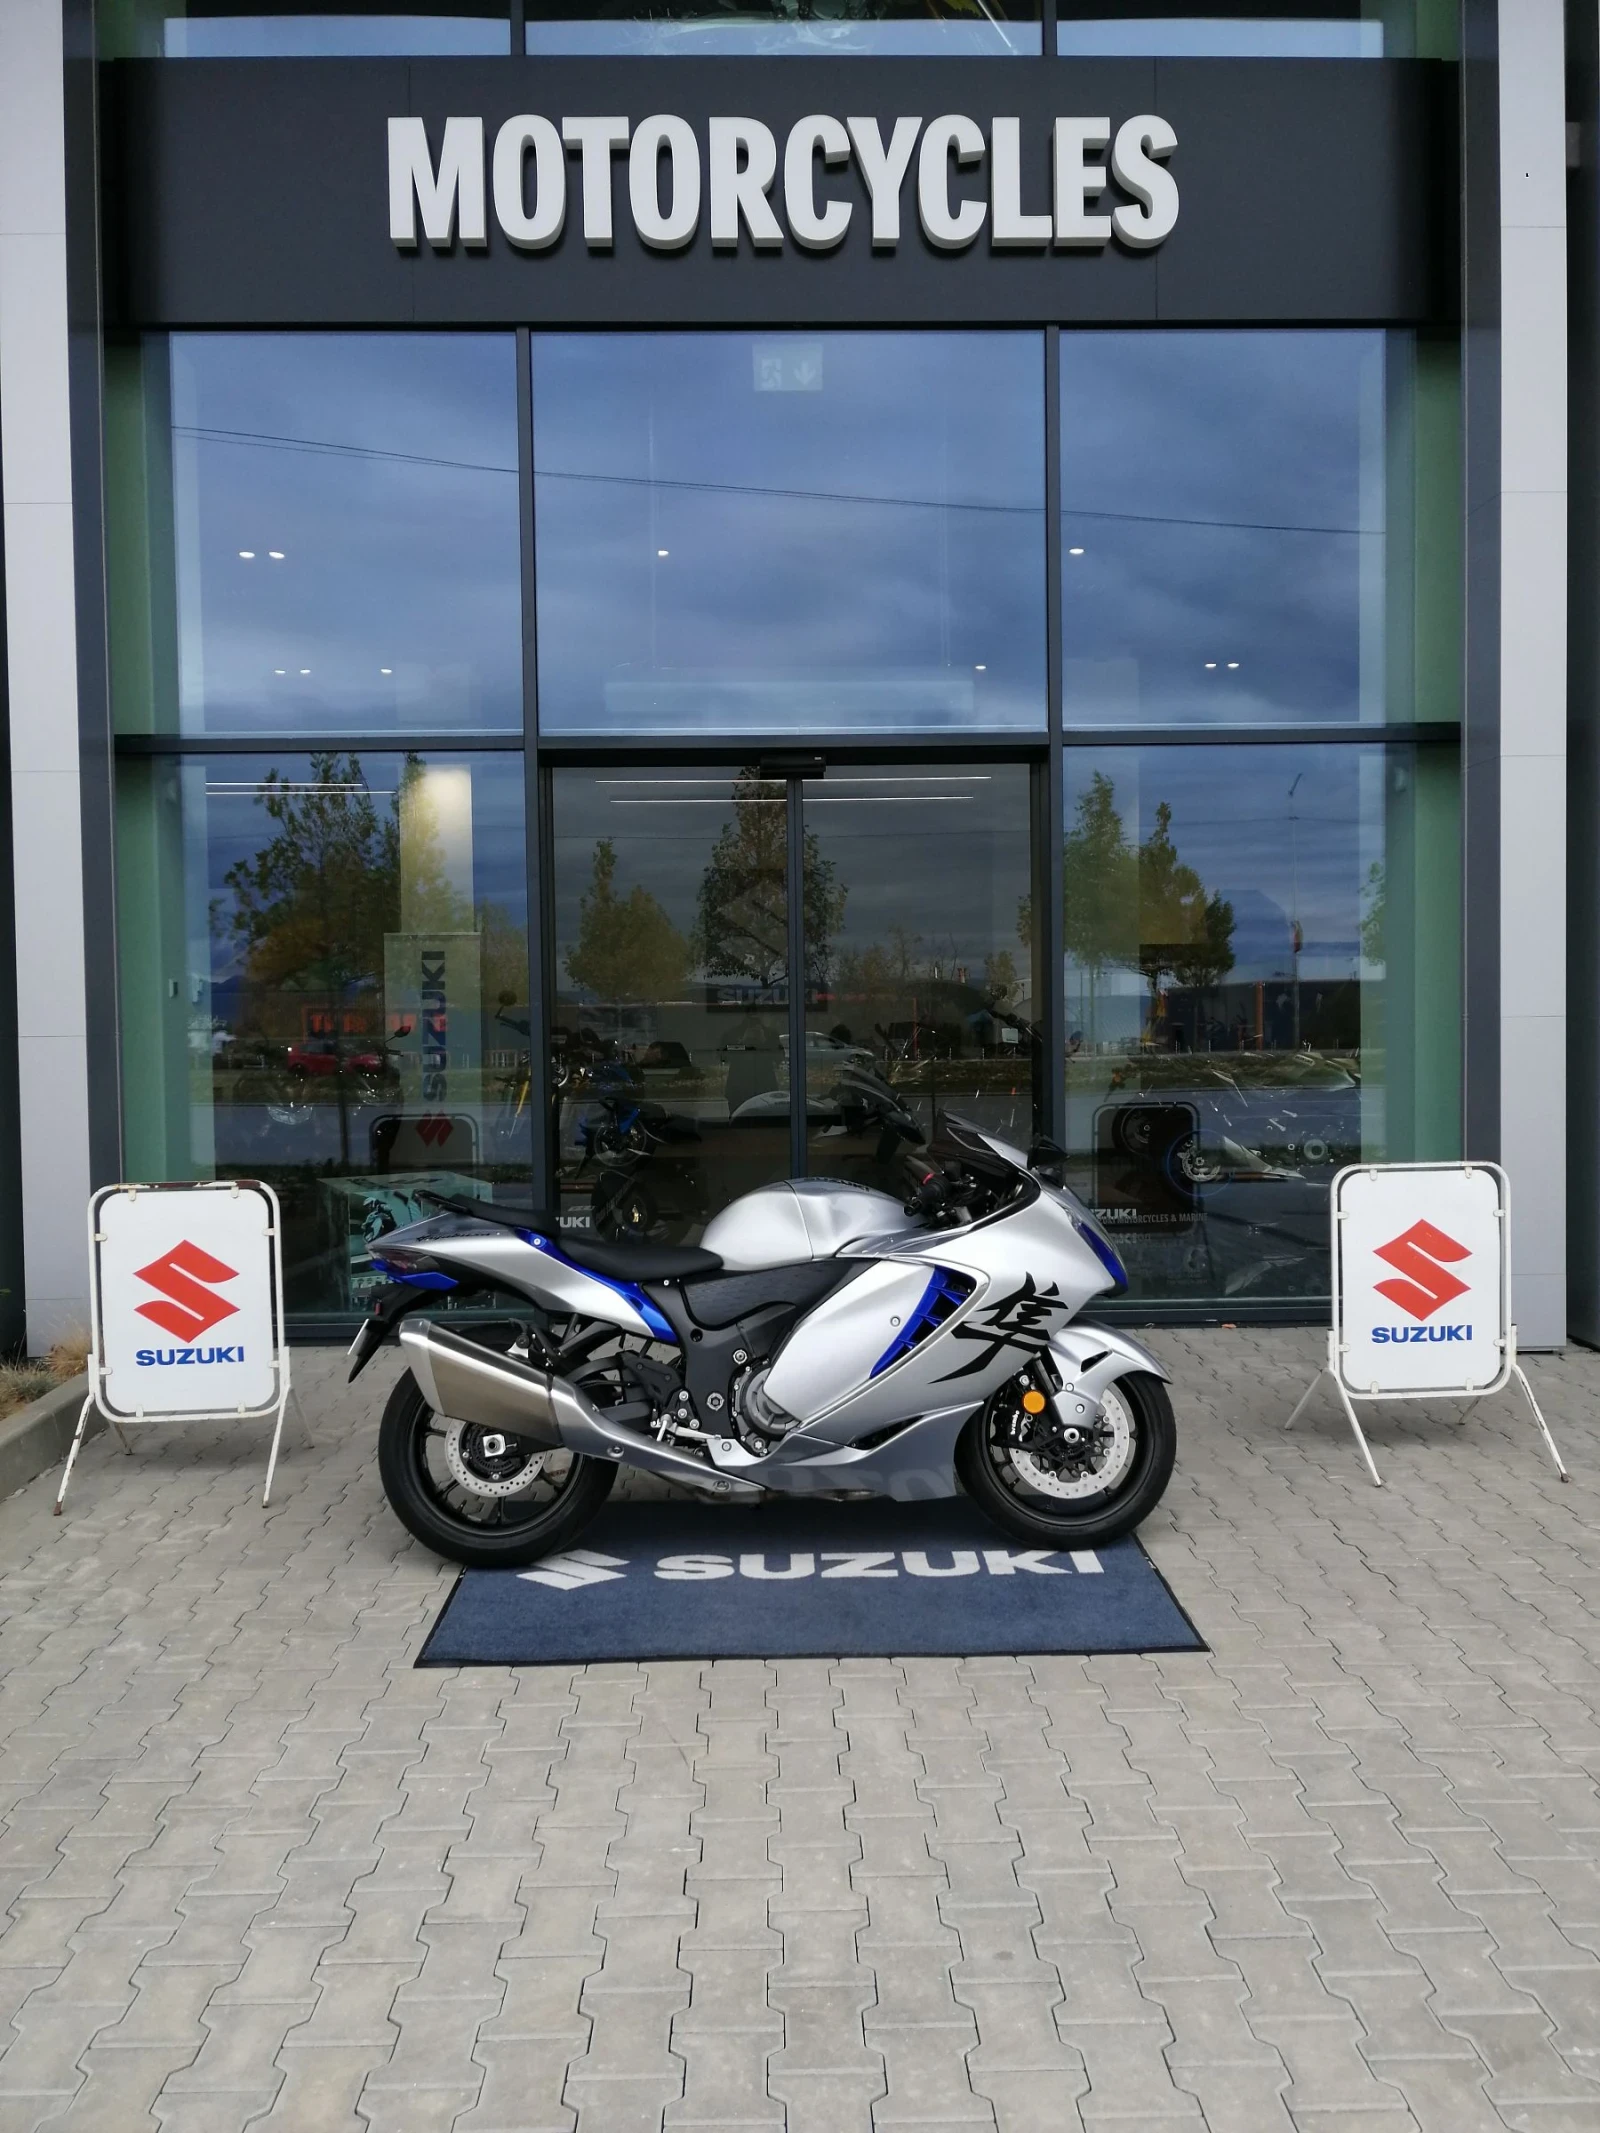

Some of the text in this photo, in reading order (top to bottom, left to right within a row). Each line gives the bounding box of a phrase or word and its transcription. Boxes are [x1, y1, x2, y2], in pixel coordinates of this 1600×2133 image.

[387, 114, 1180, 250] MOTORCYCLES
[421, 950, 447, 1101] SUZUKI
[555, 1216, 591, 1228] UKI
[927, 1271, 1069, 1385] 隼
[1371, 1324, 1473, 1344] SUZUKI
[135, 1346, 244, 1367] SUZUKI
[653, 1549, 1105, 1580] SUZUKI
